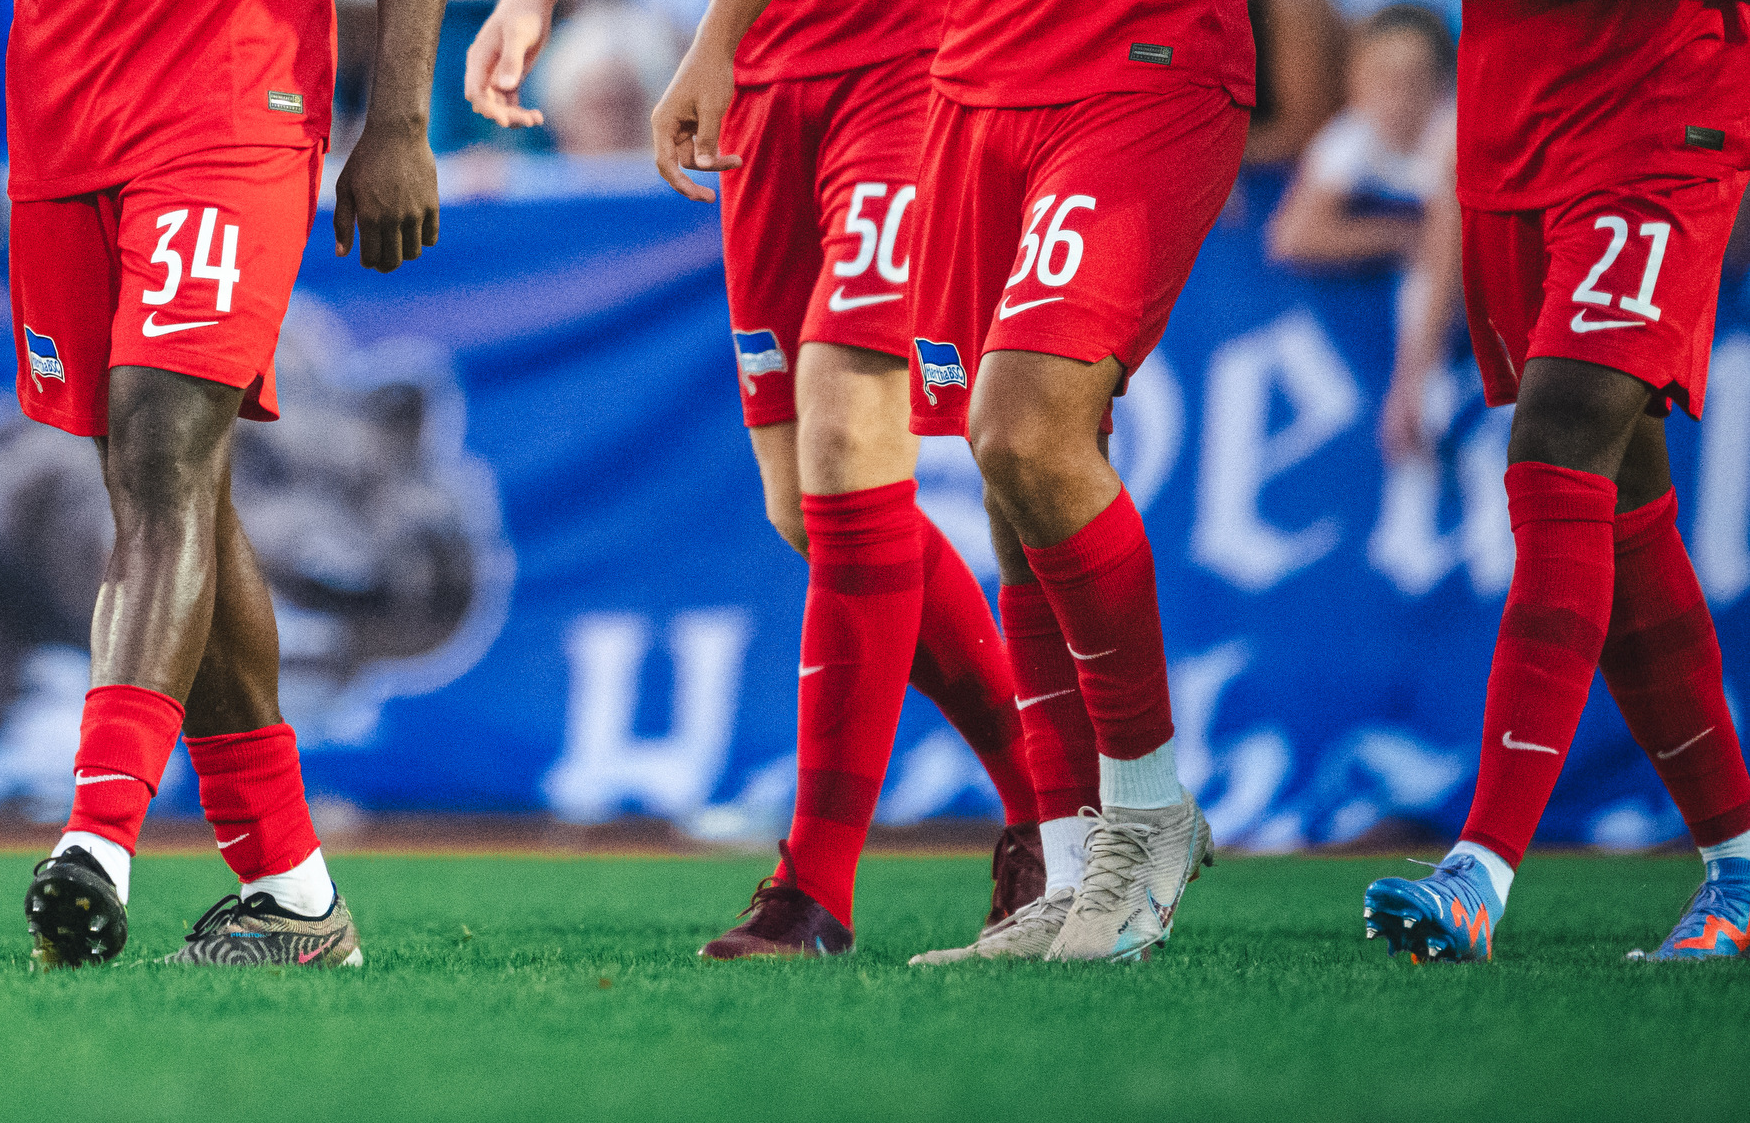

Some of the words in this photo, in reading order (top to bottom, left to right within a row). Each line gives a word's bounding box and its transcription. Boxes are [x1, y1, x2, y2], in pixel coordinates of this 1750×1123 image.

[142, 207, 241, 313] 34
[834, 181, 917, 284] 50
[1005, 194, 1097, 288] 36
[1572, 215, 1671, 322] 21
